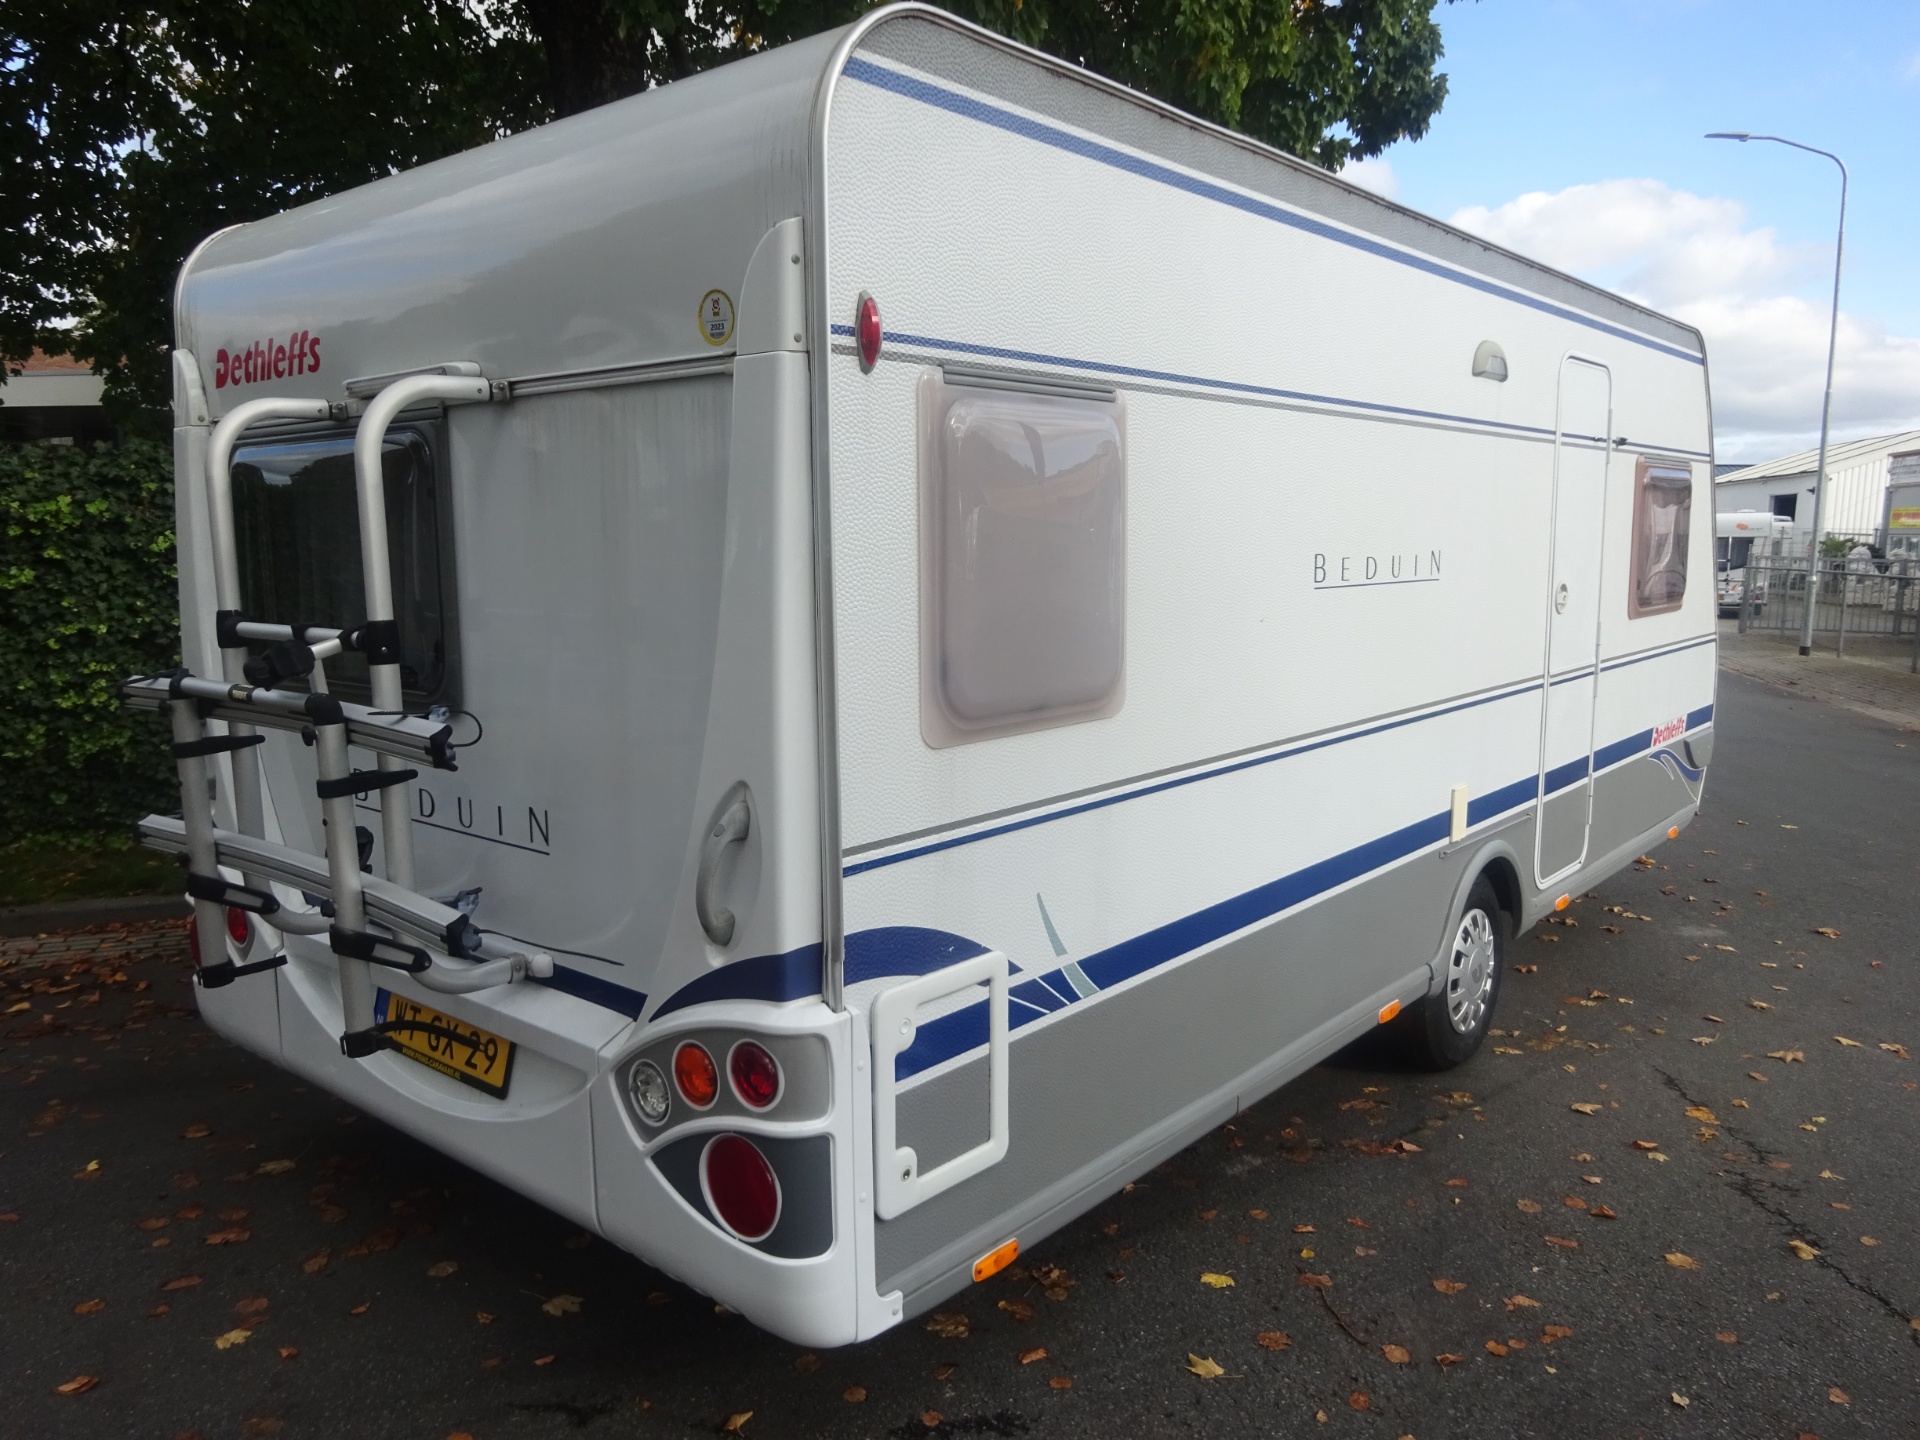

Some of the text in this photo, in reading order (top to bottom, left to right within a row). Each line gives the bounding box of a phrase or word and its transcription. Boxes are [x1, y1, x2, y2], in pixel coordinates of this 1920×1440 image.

[710, 322, 725, 331] 2023
[215, 329, 321, 389] Dethleffs
[1313, 550, 1441, 583] BEDUIN
[1653, 716, 1685, 747] Dethleffs
[353, 768, 549, 846] DUIN
[394, 998, 499, 1075] WT GX 29
